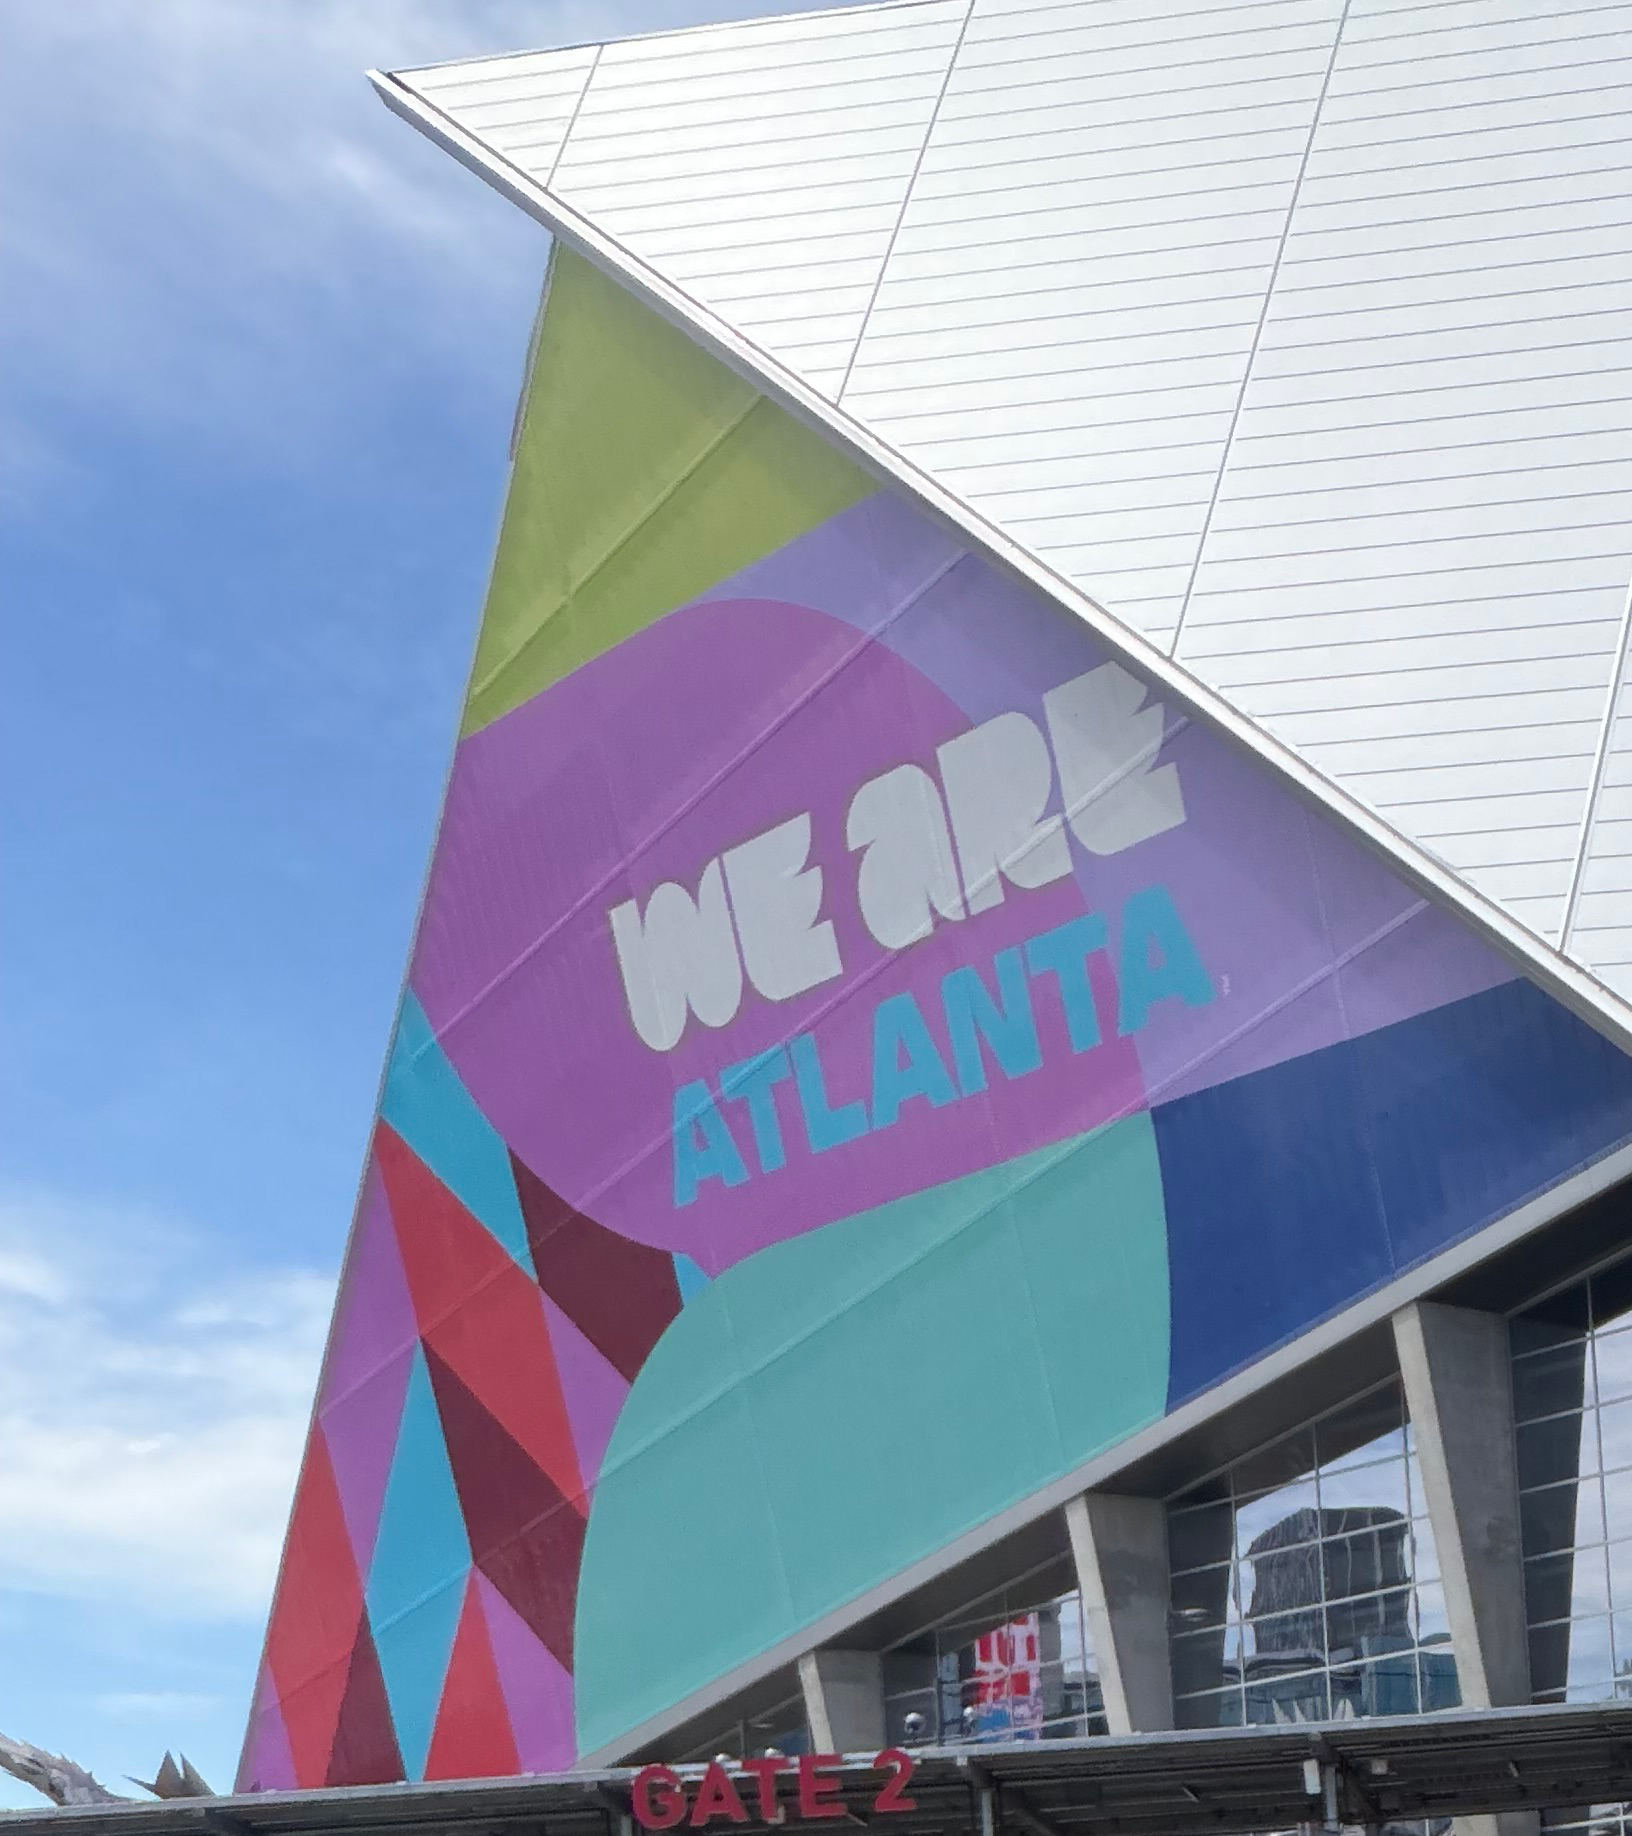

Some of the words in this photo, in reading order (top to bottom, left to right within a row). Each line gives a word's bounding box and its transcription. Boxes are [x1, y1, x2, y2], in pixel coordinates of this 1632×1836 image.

[609, 811, 843, 1052] WE
[673, 884, 1218, 1209] ATLANTA
[631, 1753, 848, 1830] GATE
[873, 1747, 917, 1813] 2
